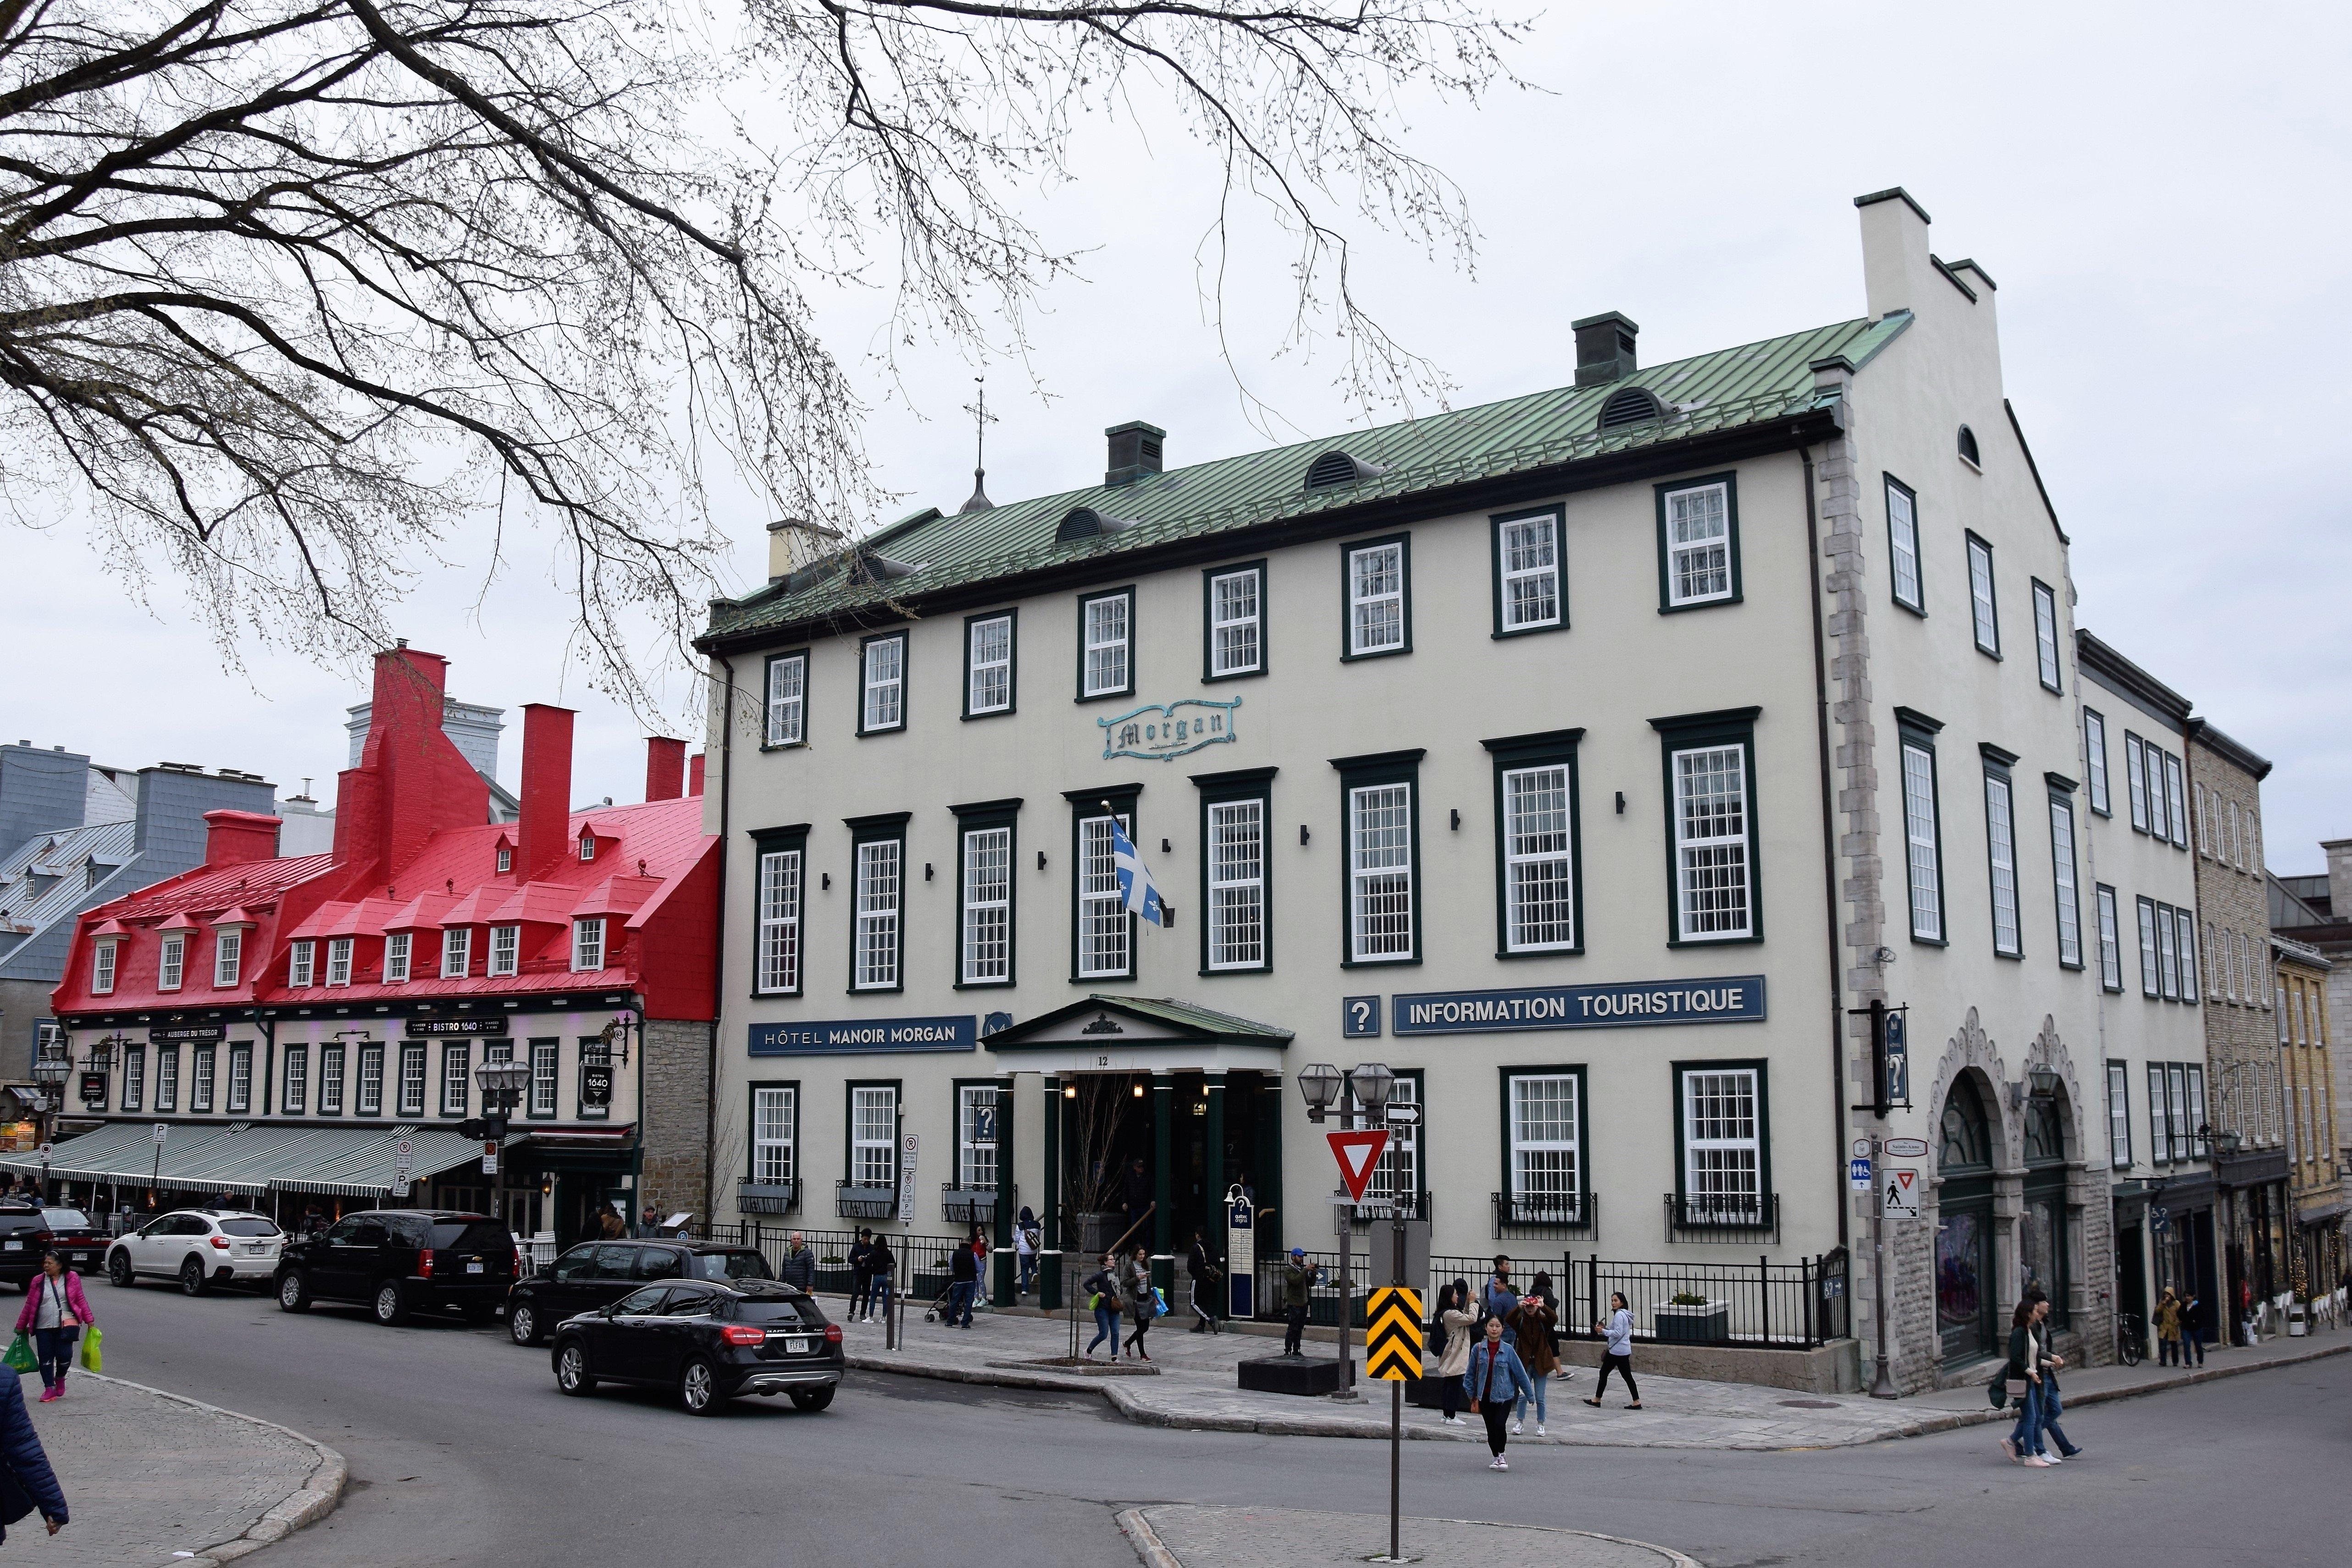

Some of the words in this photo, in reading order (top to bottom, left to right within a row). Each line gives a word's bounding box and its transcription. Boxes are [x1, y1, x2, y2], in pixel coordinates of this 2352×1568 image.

[1118, 714, 1222, 749] Morgan
[1410, 997, 1565, 1024] INFORMATION
[1578, 988, 1743, 1016] TOURISTIQUE
[1351, 1001, 1370, 1031] ?
[199, 1028, 218, 1036] TRÉSOR
[433, 1022, 459, 1031] BISTRO
[461, 1022, 477, 1031] 1640
[765, 1030, 822, 1044] HÔTEL
[830, 1029, 885, 1044] MANOIR
[891, 1026, 955, 1042] MORGAN
[1098, 1056, 1108, 1066] 12
[1889, 1057, 1901, 1095] ?
[587, 1078, 608, 1087] 1640
[981, 1108, 992, 1135] ?
[157, 1125, 164, 1134] P
[1239, 1200, 1245, 1211] ?
[790, 1342, 805, 1350] FLFAN
